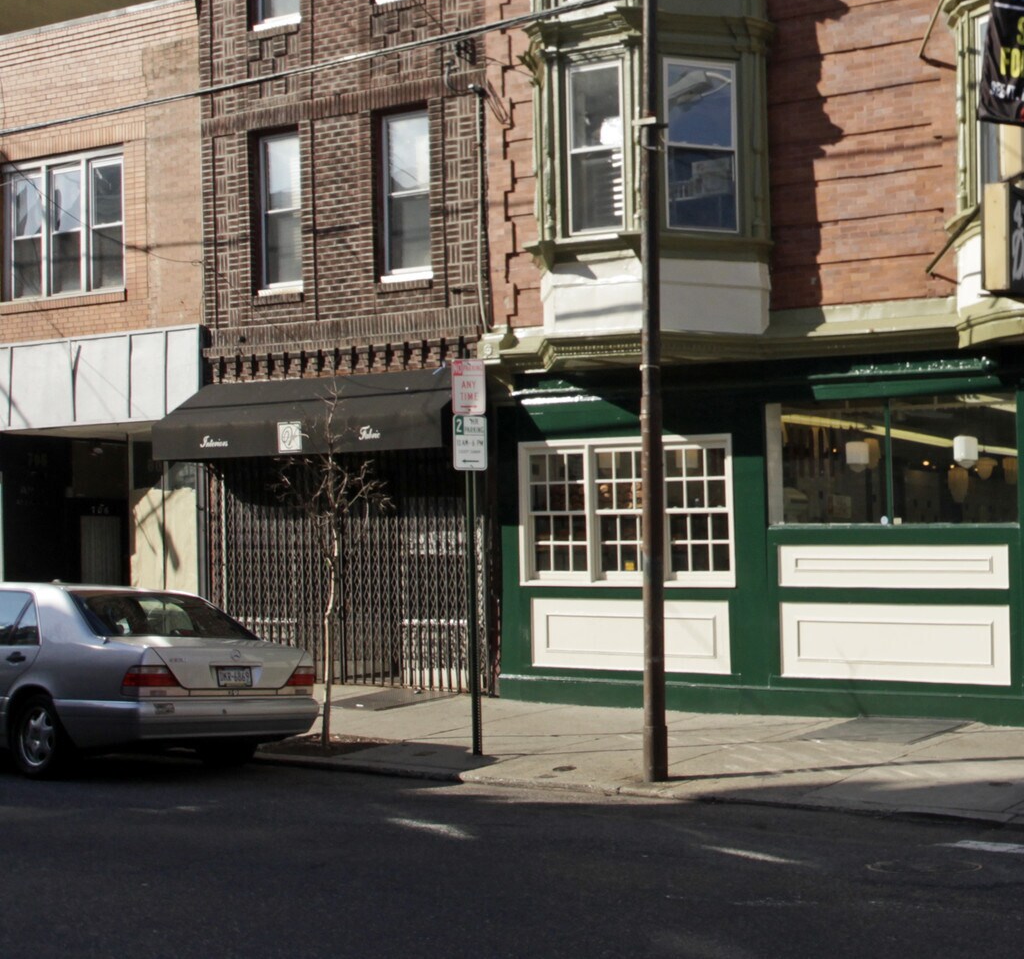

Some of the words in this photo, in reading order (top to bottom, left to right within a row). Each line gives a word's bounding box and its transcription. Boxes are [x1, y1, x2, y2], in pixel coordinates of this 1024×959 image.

[461, 380, 477, 390] ANY
[460, 392, 479, 402] TIME
[358, 425, 381, 440] Fabric
[455, 418, 464, 434] 2
[199, 435, 229, 449] Interiors
